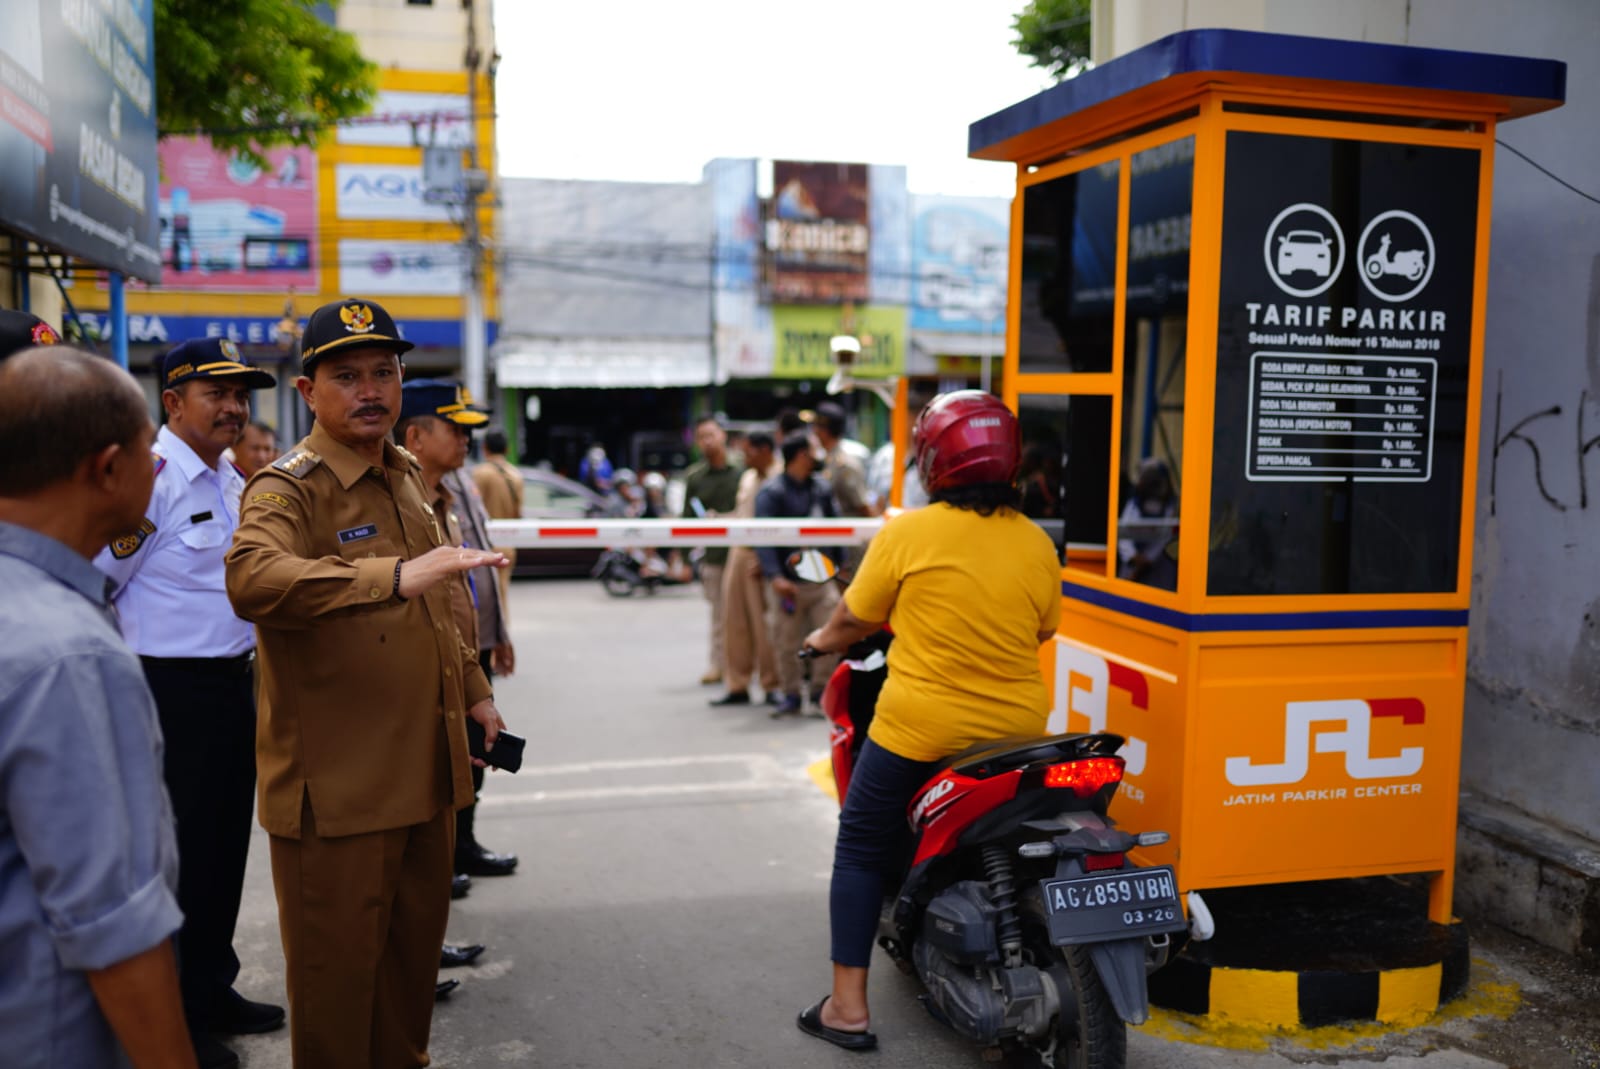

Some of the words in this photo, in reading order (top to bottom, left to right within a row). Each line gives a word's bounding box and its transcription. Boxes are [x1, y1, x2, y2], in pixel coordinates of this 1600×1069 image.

[1246, 303, 1332, 327] TARIF
[1341, 307, 1446, 331] PARKIR
[1248, 331, 1287, 345] Sesuai
[1290, 333, 1323, 347] Perda
[1380, 336, 1412, 349] Tahun
[1414, 338, 1440, 350] 2018
[1118, 781, 1145, 804] TER
[1224, 792, 1275, 806] JATIM
[1282, 788, 1347, 802] PARKIR
[1354, 783, 1422, 798] CENTER
[1055, 887, 1080, 910] AG
[1082, 881, 1131, 906] 2859
[1135, 877, 1172, 900] VBH
